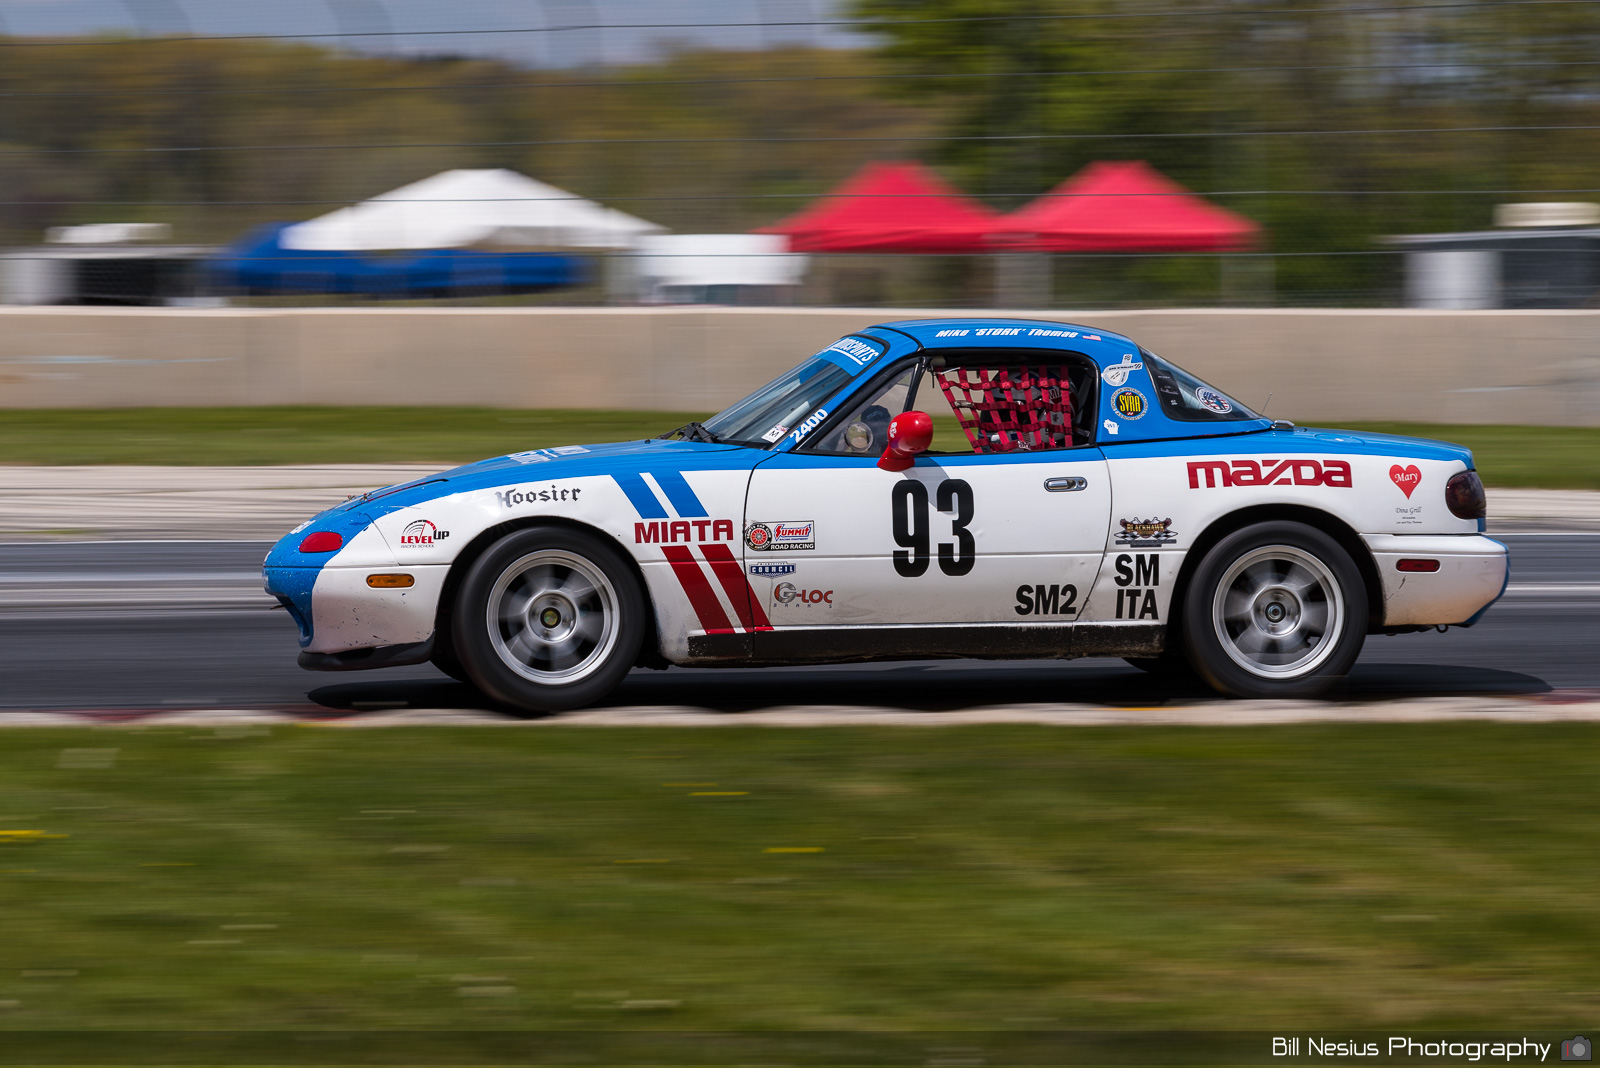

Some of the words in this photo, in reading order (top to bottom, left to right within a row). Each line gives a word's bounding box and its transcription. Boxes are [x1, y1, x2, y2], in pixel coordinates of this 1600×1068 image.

[1119, 394, 1141, 412] SVRA
[790, 408, 828, 443] 2400
[1394, 473, 1418, 484] Mary
[495, 484, 581, 508] Hoosier
[401, 535, 435, 544] LEVEL
[433, 529, 450, 540] UP
[634, 519, 734, 544] MIATA
[892, 478, 976, 578] 93
[1113, 553, 1160, 587] SM
[774, 582, 833, 604] G-LOC
[1014, 584, 1078, 615] SM2
[1115, 589, 1159, 620] ITA
